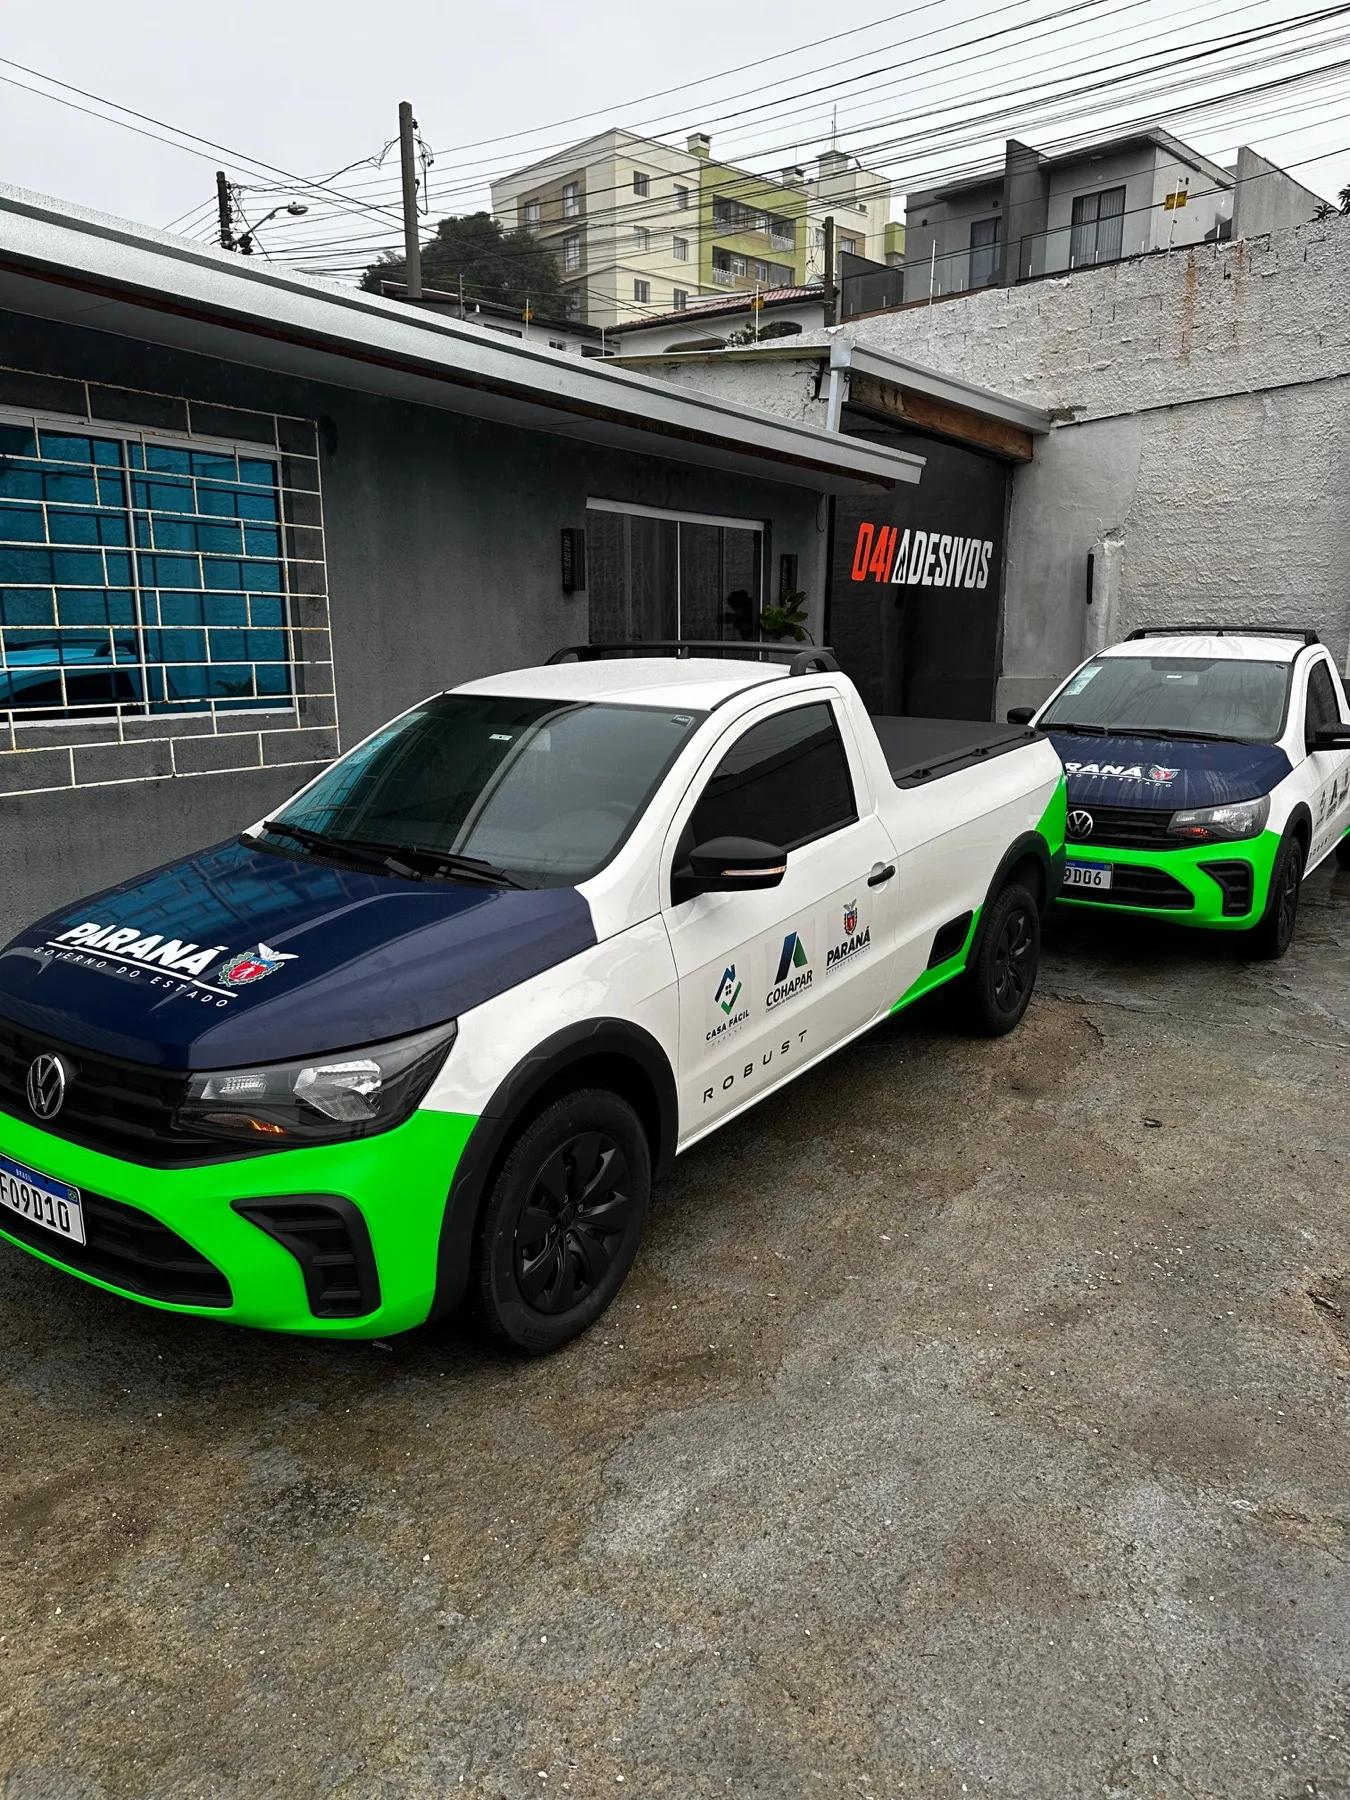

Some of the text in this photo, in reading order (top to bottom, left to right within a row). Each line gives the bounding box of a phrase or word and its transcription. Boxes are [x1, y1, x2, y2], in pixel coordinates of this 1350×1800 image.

[55, 922, 229, 975] PARANÁ
[826, 925, 870, 967] PARANÁ
[33, 946, 228, 1007] GOVERNO DO ESTADO
[766, 969, 812, 1007] COHAPAR
[706, 1023, 726, 1040] CASA
[703, 1029, 807, 1103] ROBUST
